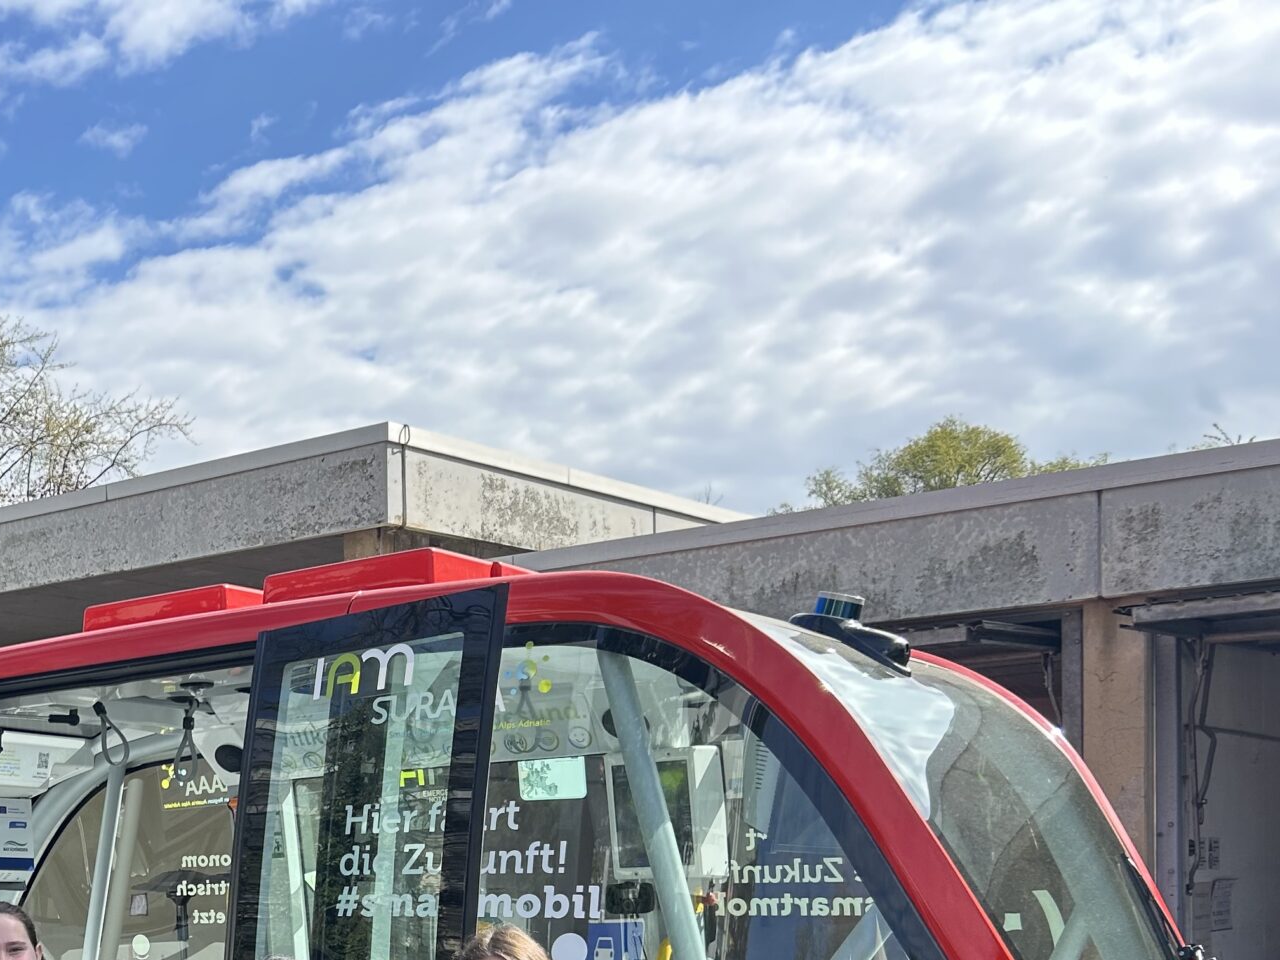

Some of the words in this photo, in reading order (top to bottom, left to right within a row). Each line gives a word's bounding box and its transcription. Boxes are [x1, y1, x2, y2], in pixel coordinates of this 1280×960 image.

[313, 643, 415, 700] IAM
[345, 801, 417, 835] Hier
[402, 840, 568, 876] Zuunft!
[336, 885, 602, 919] #smamobil
